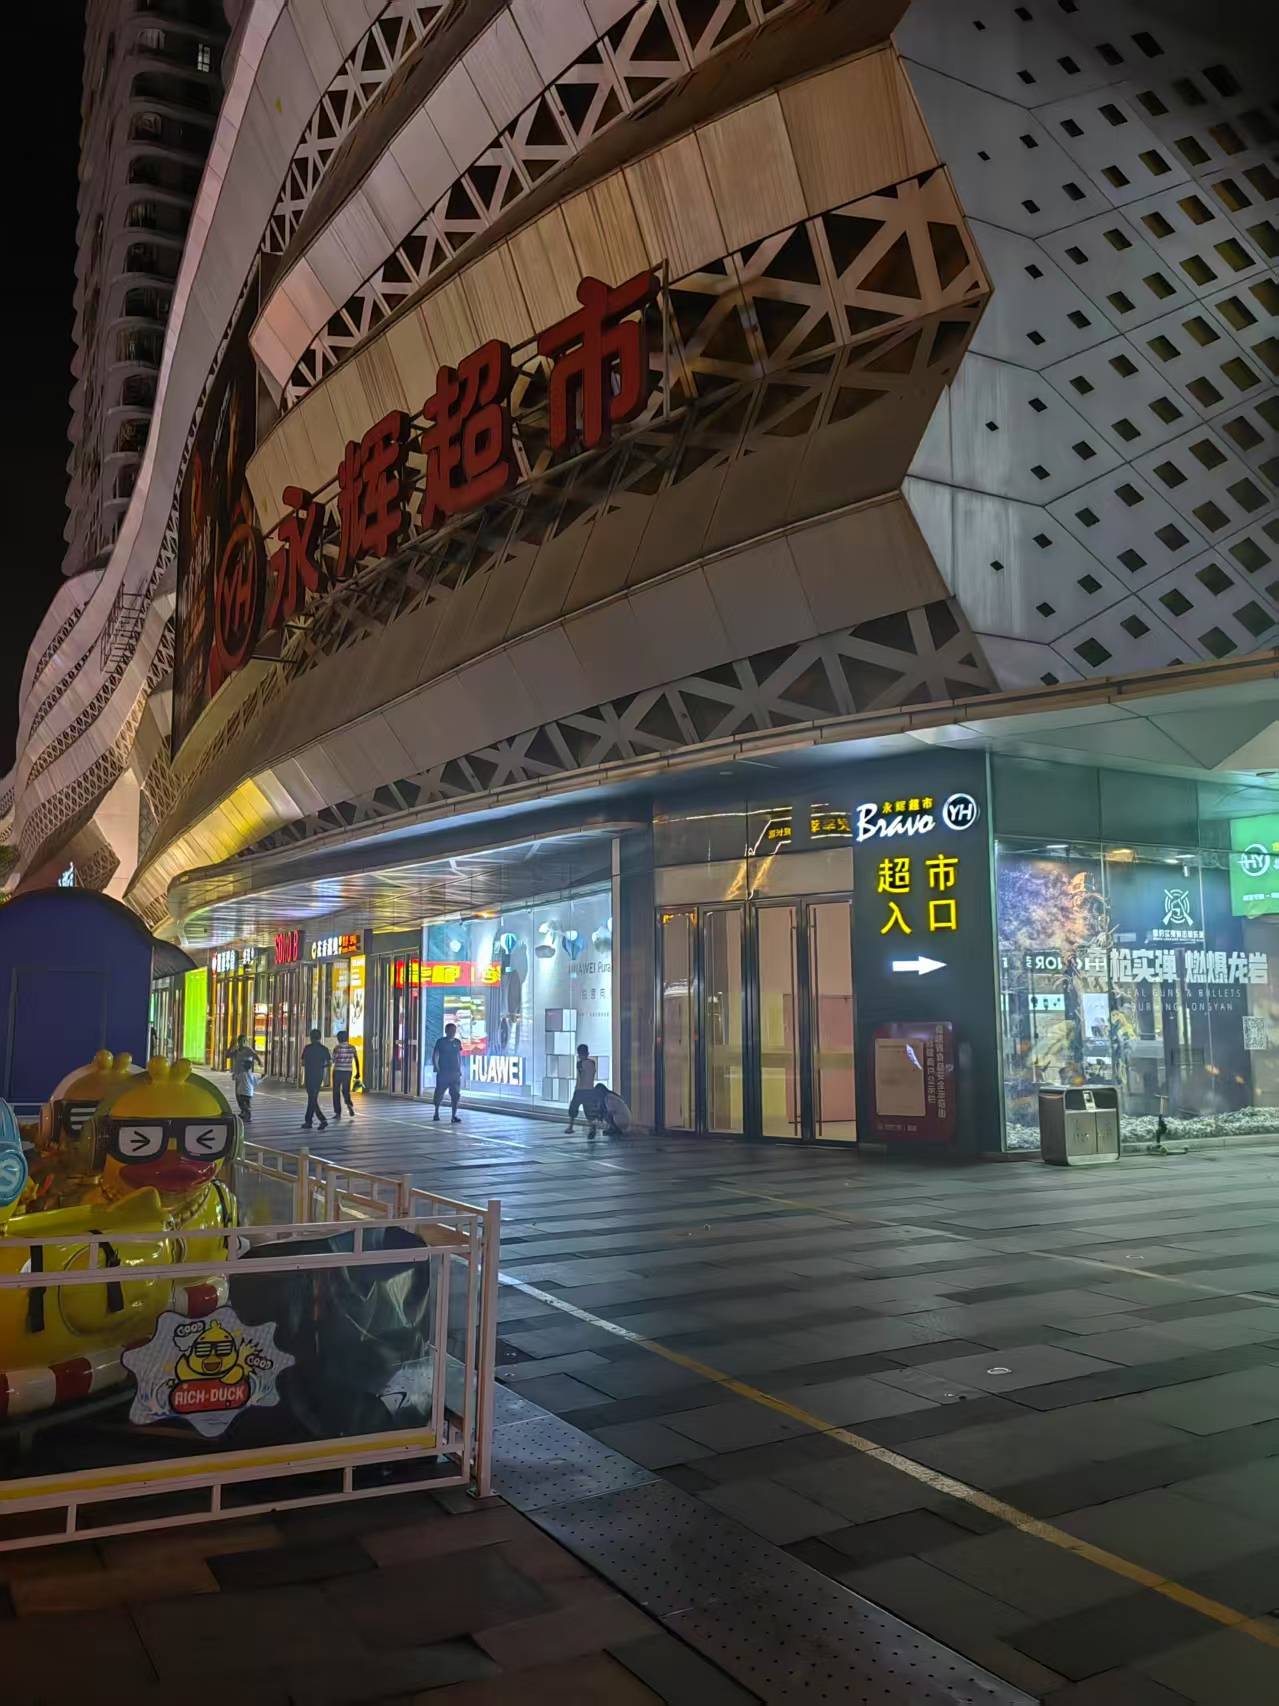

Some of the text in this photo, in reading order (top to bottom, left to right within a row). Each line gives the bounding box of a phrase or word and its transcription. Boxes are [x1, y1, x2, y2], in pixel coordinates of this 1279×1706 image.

[267, 271, 658, 630] 永辉超市
[855, 803, 936, 843] Bravo
[882, 798, 933, 814] 永辉超市
[1184, 950, 1268, 984] 燃爆龙岩
[470, 1054, 523, 1086] HUAWEI
